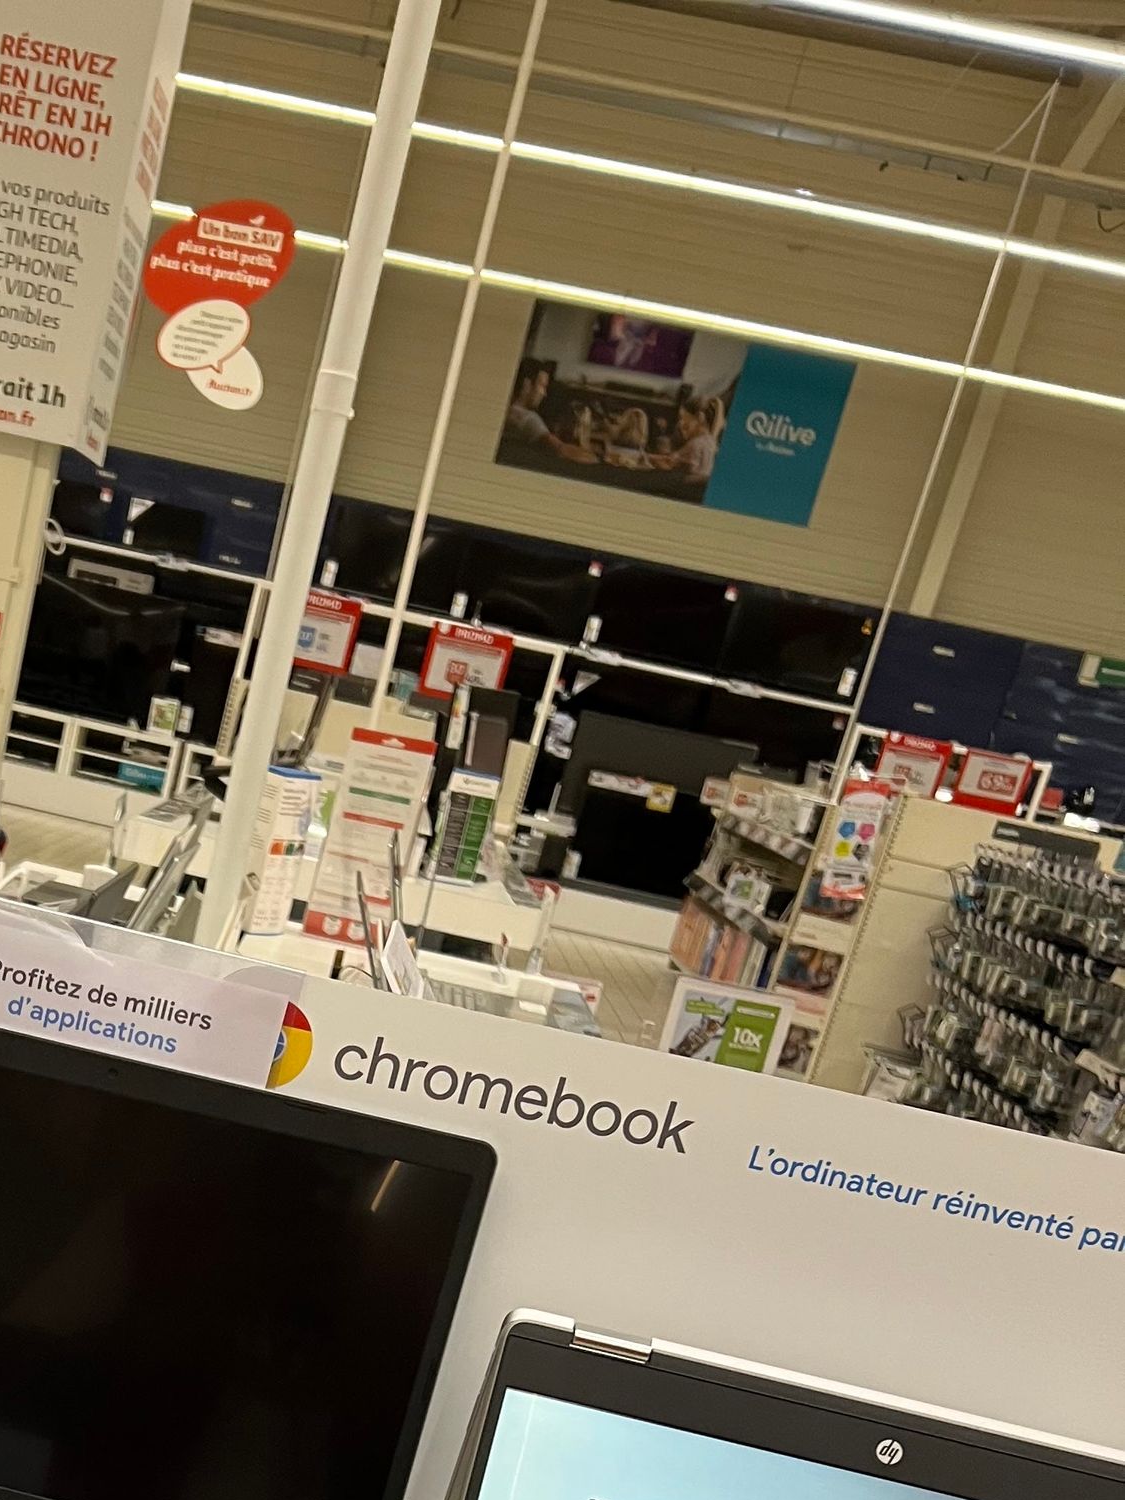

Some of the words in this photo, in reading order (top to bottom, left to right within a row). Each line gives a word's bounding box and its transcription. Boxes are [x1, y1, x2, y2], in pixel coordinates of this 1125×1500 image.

[0, 32, 117, 79] RÉSERVEZ
[34, 71, 105, 109] LIGNE,
[45, 103, 77, 128] EN
[81, 110, 113, 136] 1H
[2, 180, 31, 198] vos
[34, 186, 111, 216] produits
[28, 206, 79, 236] TECH,
[252, 231, 280, 247] SAV
[177, 240, 207, 255] plus
[208, 245, 239, 261] c'est
[150, 255, 180, 270] plus
[182, 260, 212, 276] c'est
[212, 268, 271, 288] pratique
[38, 383, 67, 408] 1h
[746, 410, 816, 447] Qilive
[7, 996, 177, 1054] d'applications
[87, 984, 119, 1008] de
[124, 995, 213, 1031] milliers
[333, 1035, 695, 1155] chromebook
[748, 1145, 929, 1207] L'ordinateur
[932, 1191, 1074, 1241] réinventé
